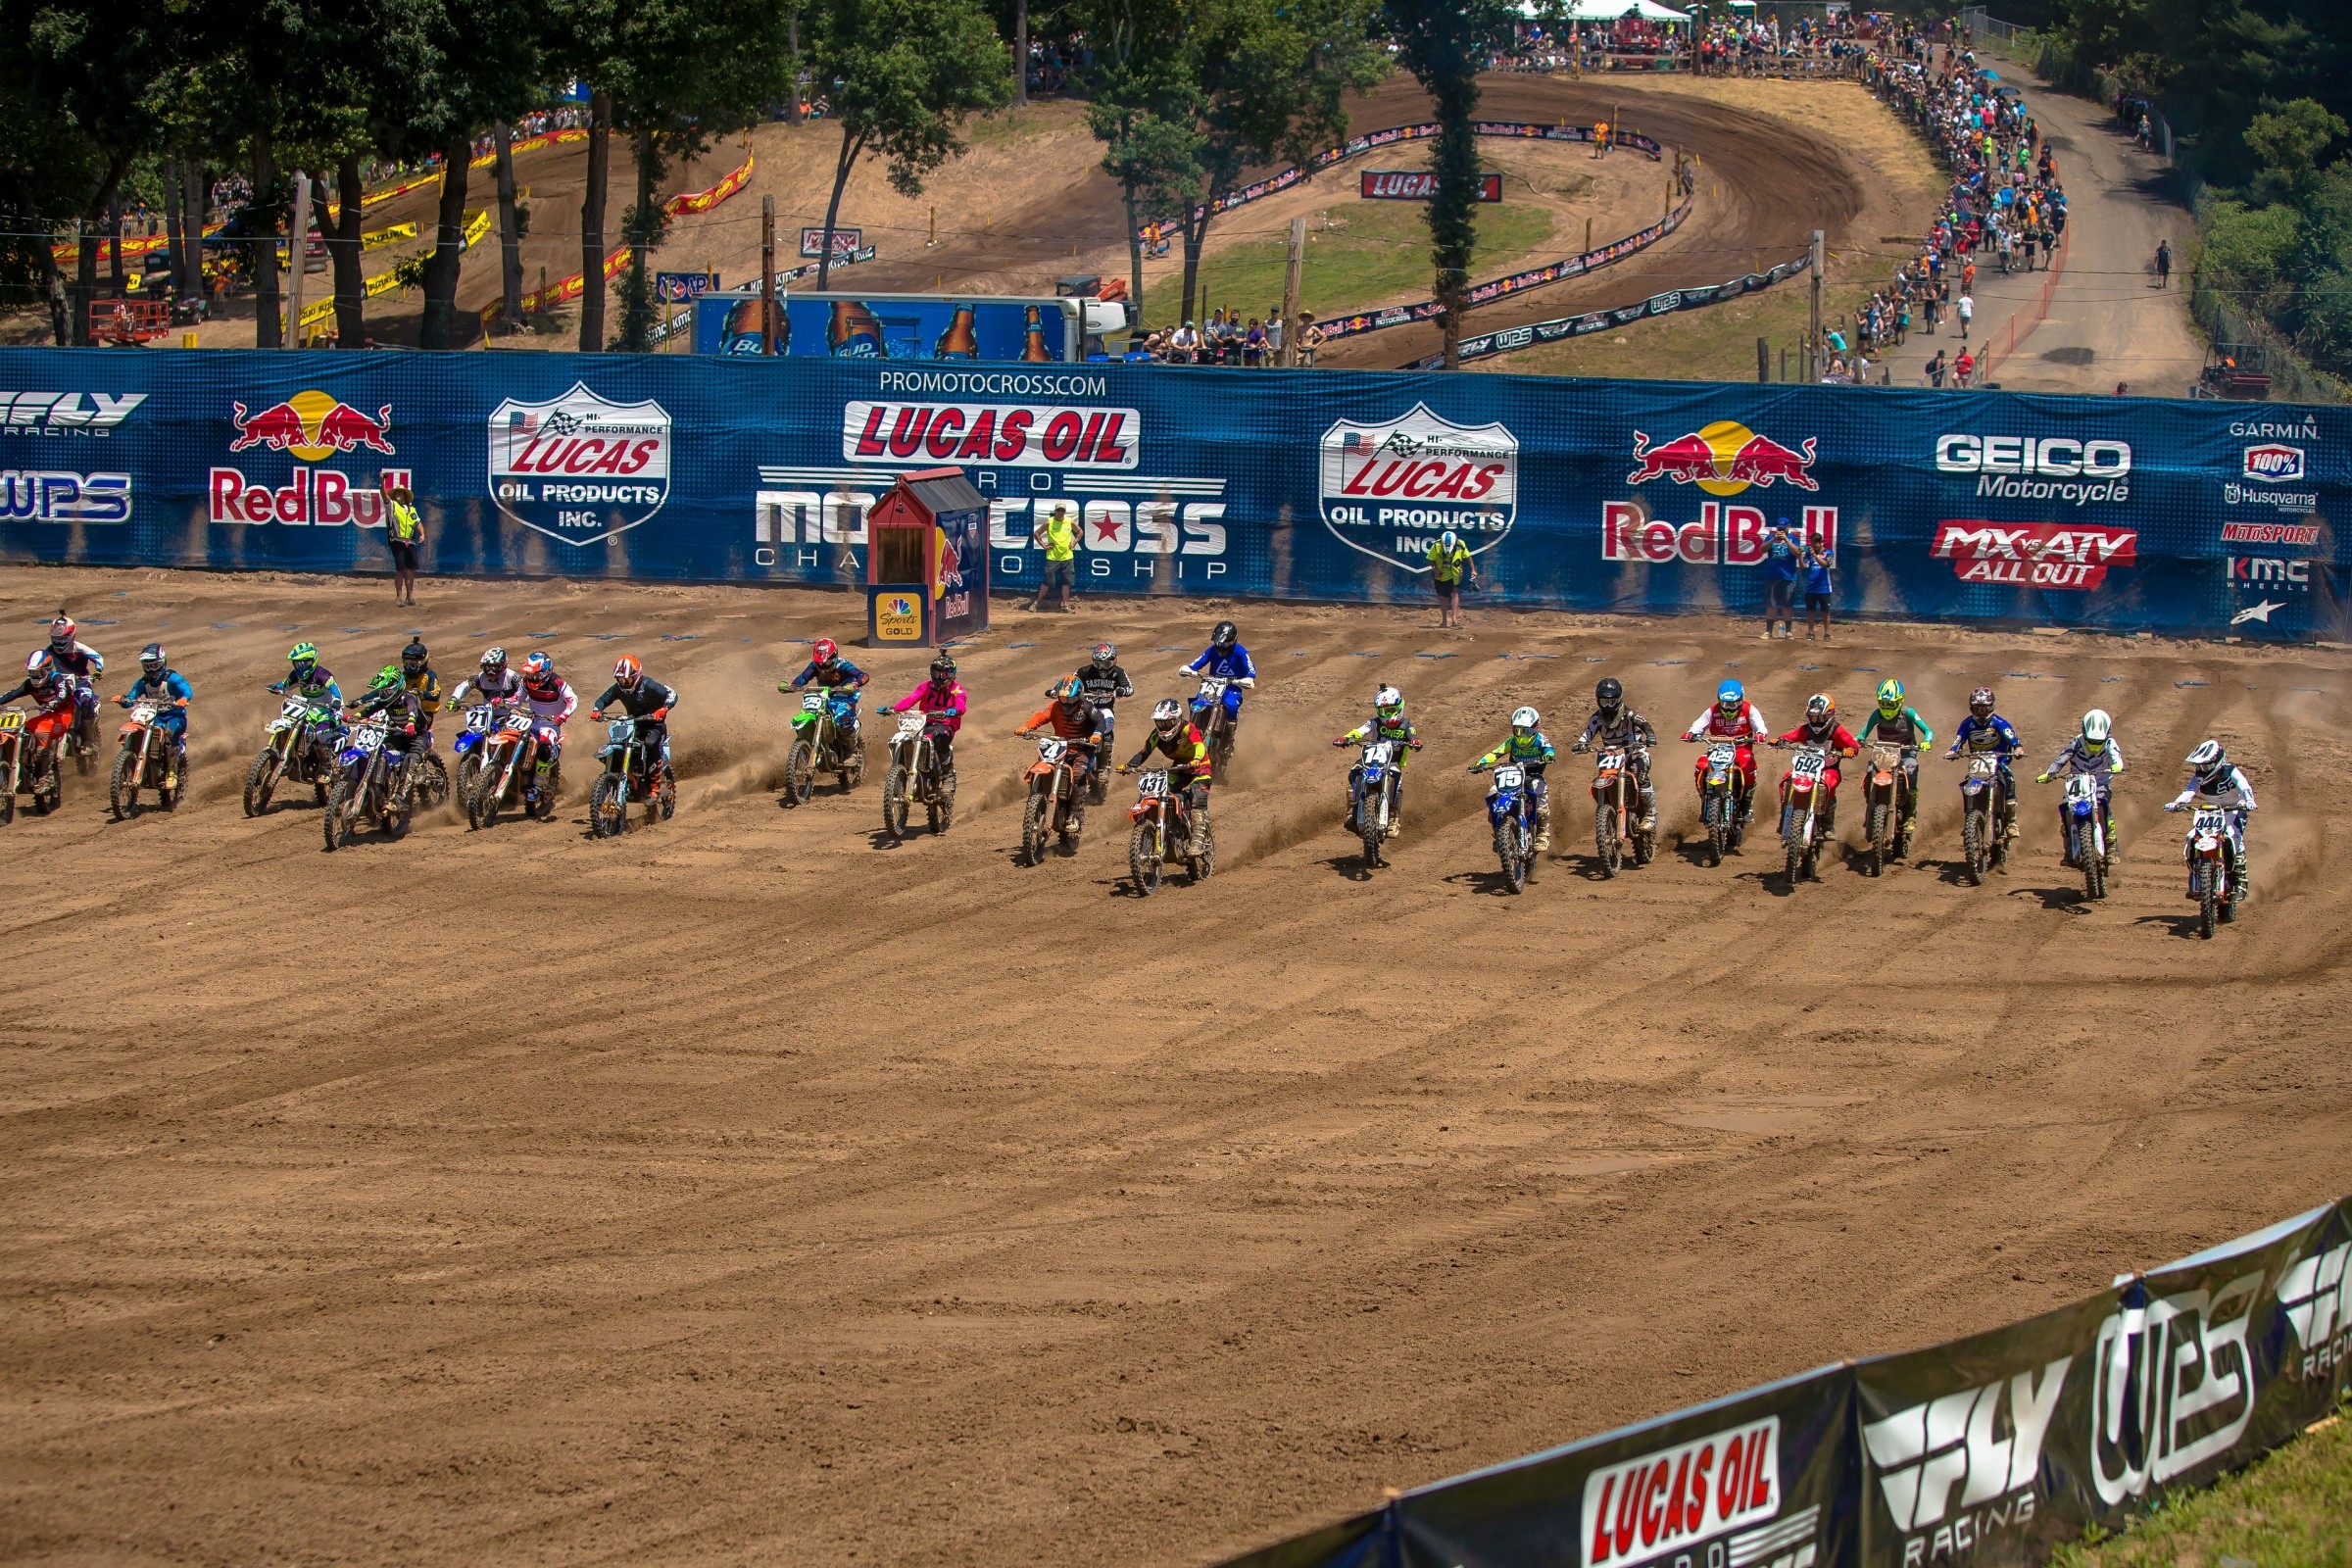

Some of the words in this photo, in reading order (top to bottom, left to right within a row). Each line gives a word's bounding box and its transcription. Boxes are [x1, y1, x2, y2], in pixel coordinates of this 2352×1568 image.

[365, 228, 403, 245] SUZUKI
[734, 338, 763, 353] BU
[880, 371, 1106, 396] PROMOTOCROSS.COM
[4, 426, 110, 436] RACING
[585, 425, 663, 435] PERFORMANCE
[855, 406, 1034, 463] LUCAS
[1042, 410, 1127, 464] OIL
[2230, 421, 2318, 440] GARMIN
[510, 438, 660, 475] LUCAS
[1425, 448, 1510, 460] PERFORMANCE
[1936, 434, 2132, 478] GEICO
[2252, 453, 2296, 473] 100%
[978, 471, 1052, 491] RO
[1342, 460, 1505, 500] LUCAS
[498, 483, 535, 503] OIL
[542, 484, 660, 505] PRODUCTS
[1976, 474, 2130, 507] Motorcycle
[2242, 488, 2316, 507] Husqvarna
[558, 511, 603, 527] INC.
[756, 491, 1227, 556] MOCROSS
[1330, 507, 1371, 525] OIL
[1379, 508, 1505, 531] PRODUCTS
[1724, 505, 1838, 569] Bll
[1935, 526, 2030, 561] MX
[2028, 530, 2137, 563] ATV
[756, 548, 1227, 580] CHAOSHIP
[1959, 560, 2027, 581] ALL
[2032, 563, 2095, 585] OUT
[2227, 581, 2309, 592] WHEELS
[879, 612, 917, 626] Sports
[925, 690, 952, 708] FLY
[468, 711, 487, 728] 21
[506, 714, 532, 730] 270
[1044, 742, 1059, 759] 4
[1364, 747, 1388, 763] 14
[1707, 751, 1734, 762] 429
[1597, 755, 1624, 769] 41
[1794, 755, 1822, 773] 692
[1139, 777, 1167, 793] 431
[1495, 771, 1522, 789] 15
[2195, 816, 2223, 832] 444
[1864, 1355, 2073, 1532] FLY
[1592, 1441, 1714, 1564] LUCAS
[1717, 1426, 1770, 1520] OIL
[1903, 1492, 2035, 1568] RACING
